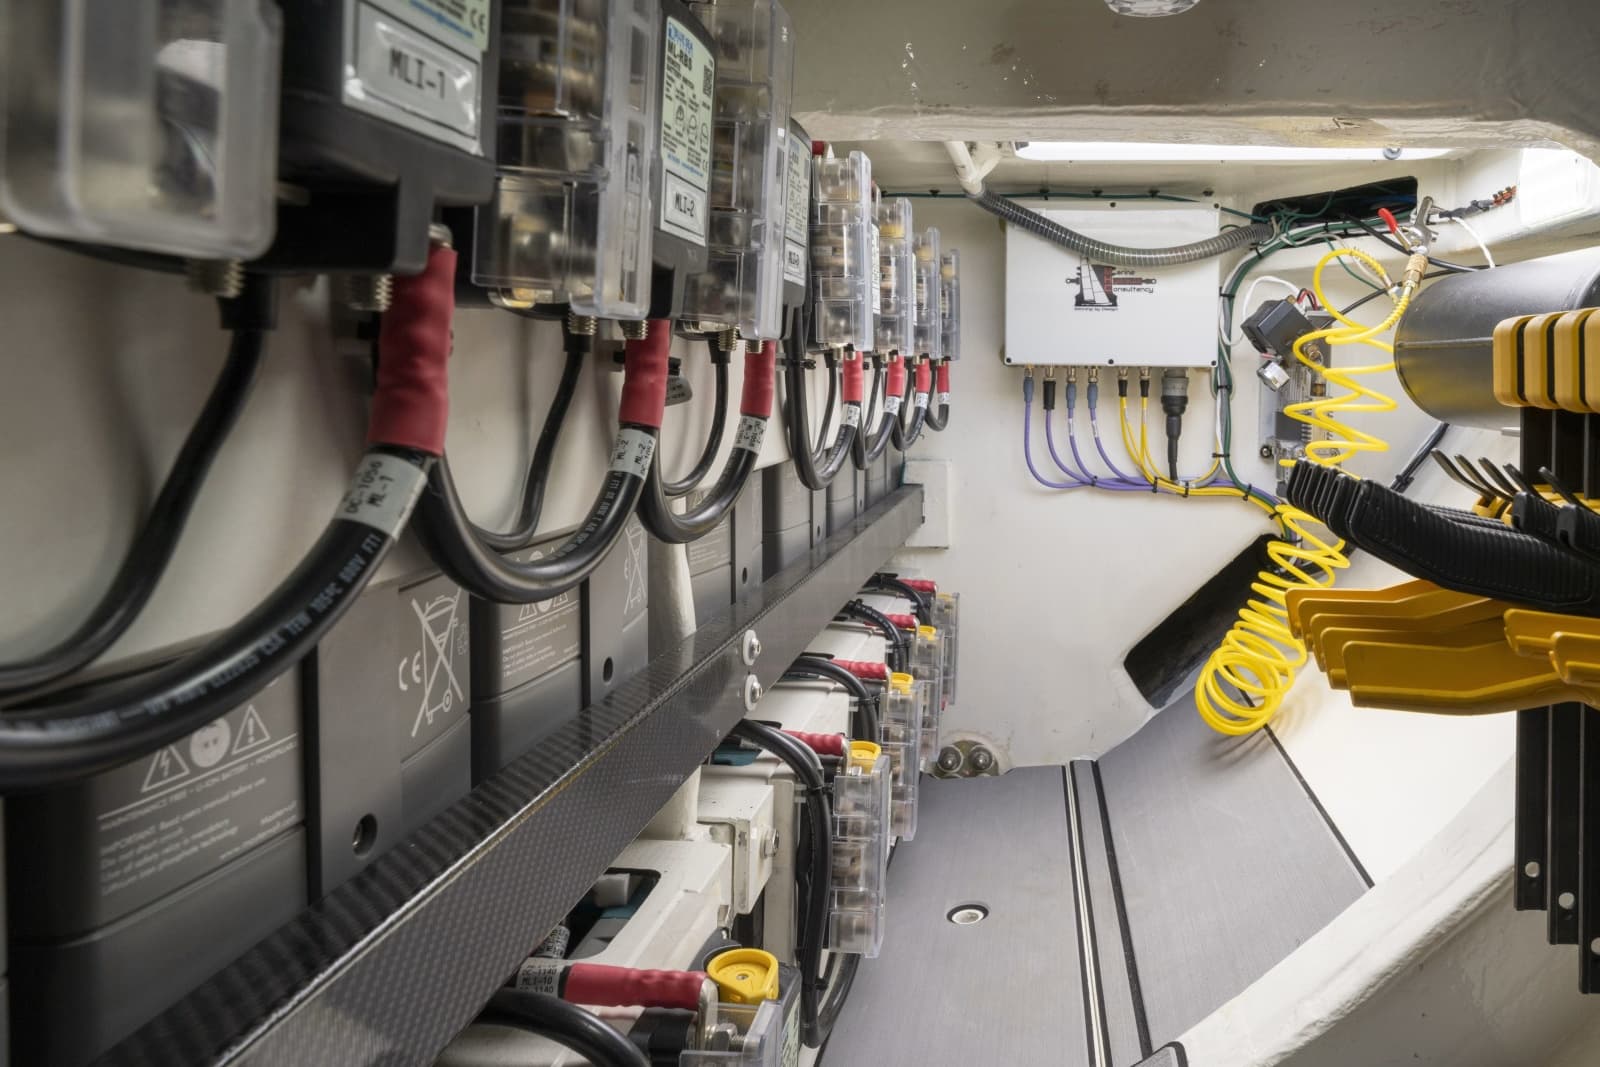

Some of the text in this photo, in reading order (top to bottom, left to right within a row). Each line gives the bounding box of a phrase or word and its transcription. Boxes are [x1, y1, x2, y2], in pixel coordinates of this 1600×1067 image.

[389, 47, 446, 100] MLI-1
[674, 191, 695, 217] MLI-2
[398, 651, 421, 691] CE
